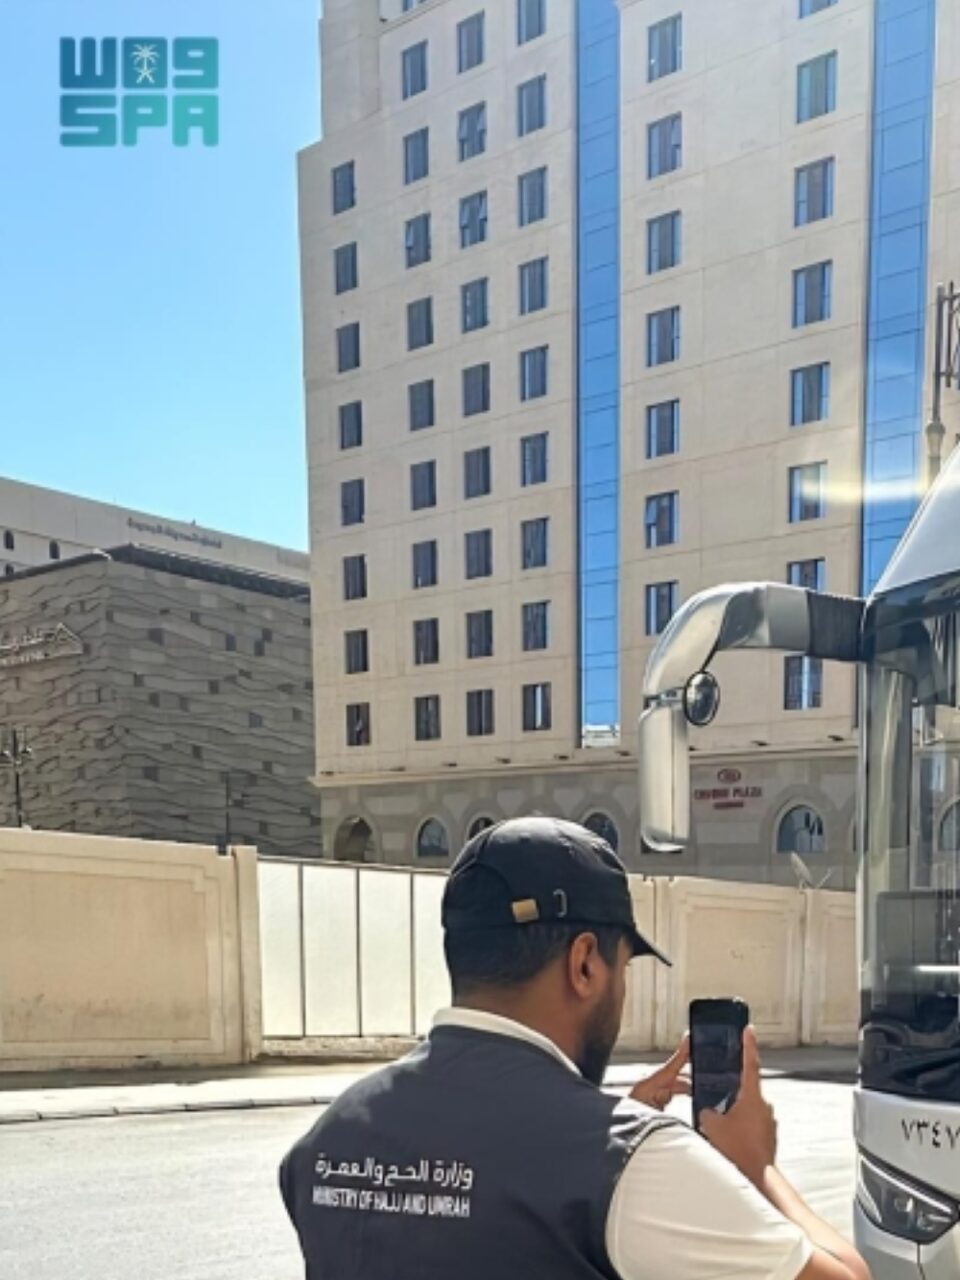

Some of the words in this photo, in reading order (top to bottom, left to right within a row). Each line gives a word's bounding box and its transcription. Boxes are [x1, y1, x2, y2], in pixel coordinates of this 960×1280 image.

[315, 1152, 384, 1186] والعمرة
[384, 1159, 430, 1188] الحج
[433, 1159, 474, 1190] وزارة
[312, 1185, 358, 1210] MINISTRY
[359, 1189, 375, 1211] OF
[402, 1192, 426, 1216] AND
